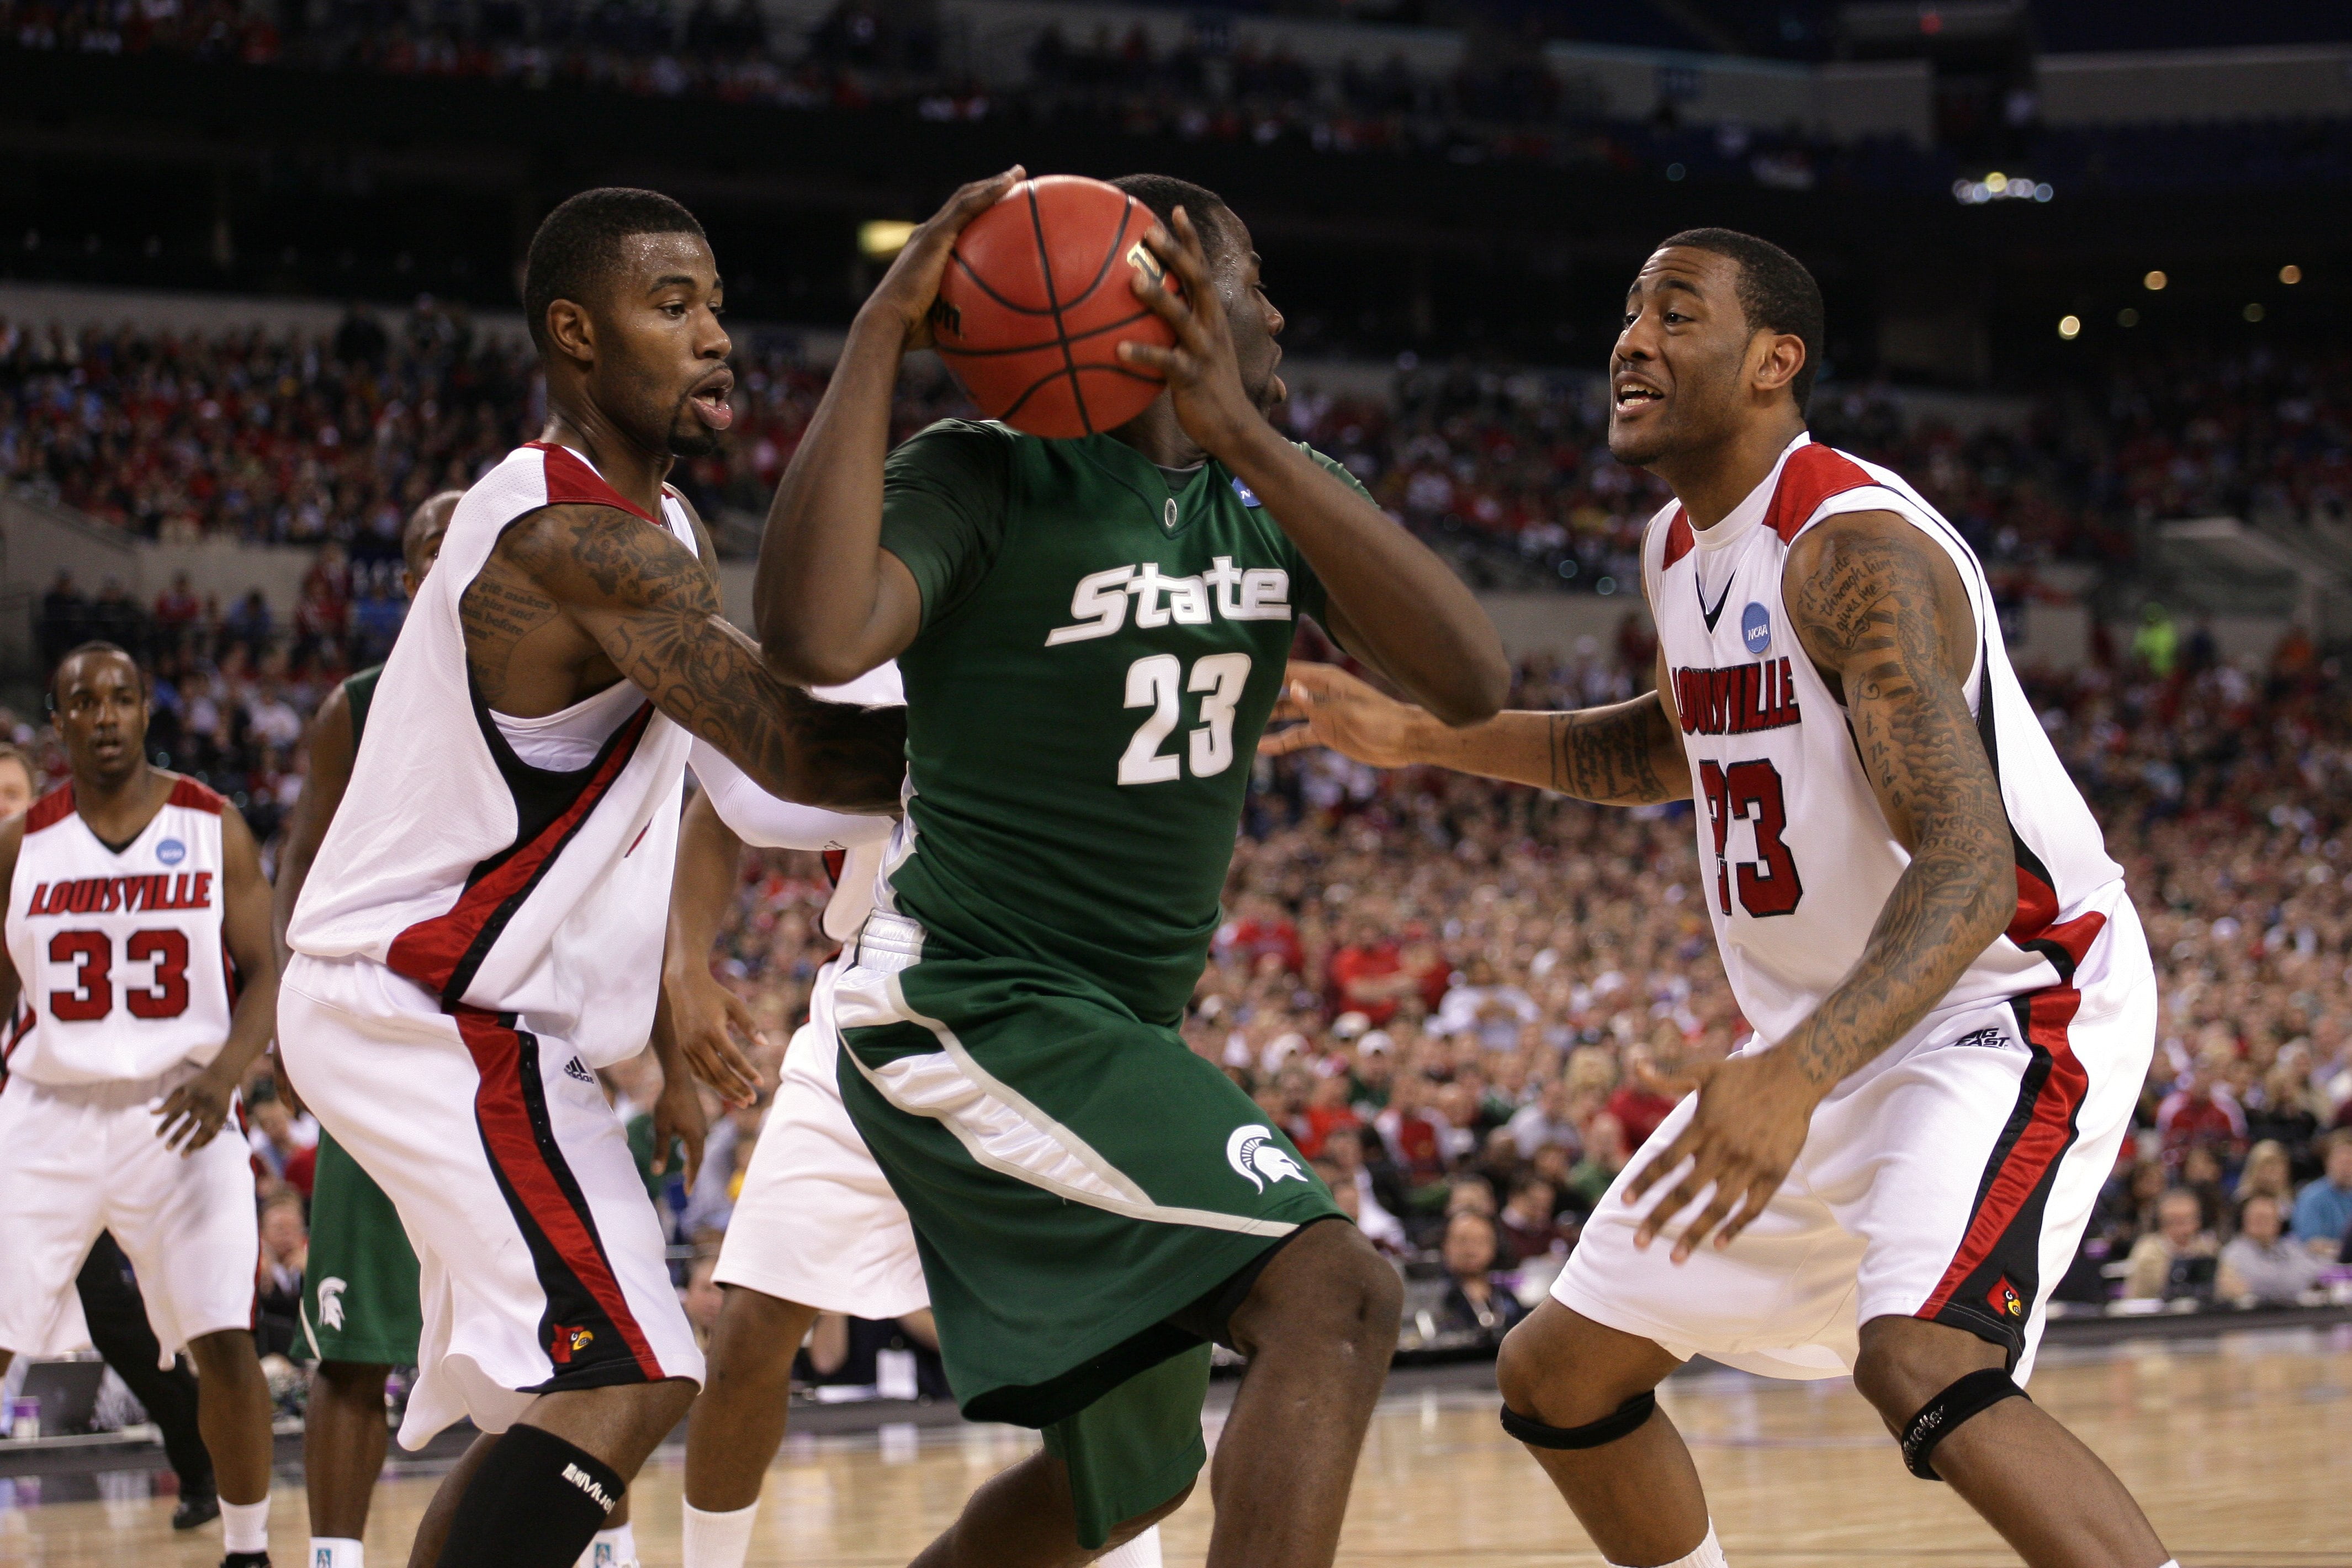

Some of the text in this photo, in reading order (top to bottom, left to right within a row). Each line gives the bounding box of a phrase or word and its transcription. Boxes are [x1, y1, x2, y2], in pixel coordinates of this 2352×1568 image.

[1044, 555, 1292, 647] State
[1747, 624, 1768, 641] NCAA
[1117, 652, 1252, 786] 23
[1671, 655, 1802, 736] OUVILLE
[25, 870, 213, 919] LOUISVILLE
[49, 929, 189, 1021] 33
[1954, 1037, 2010, 1047] EAST
